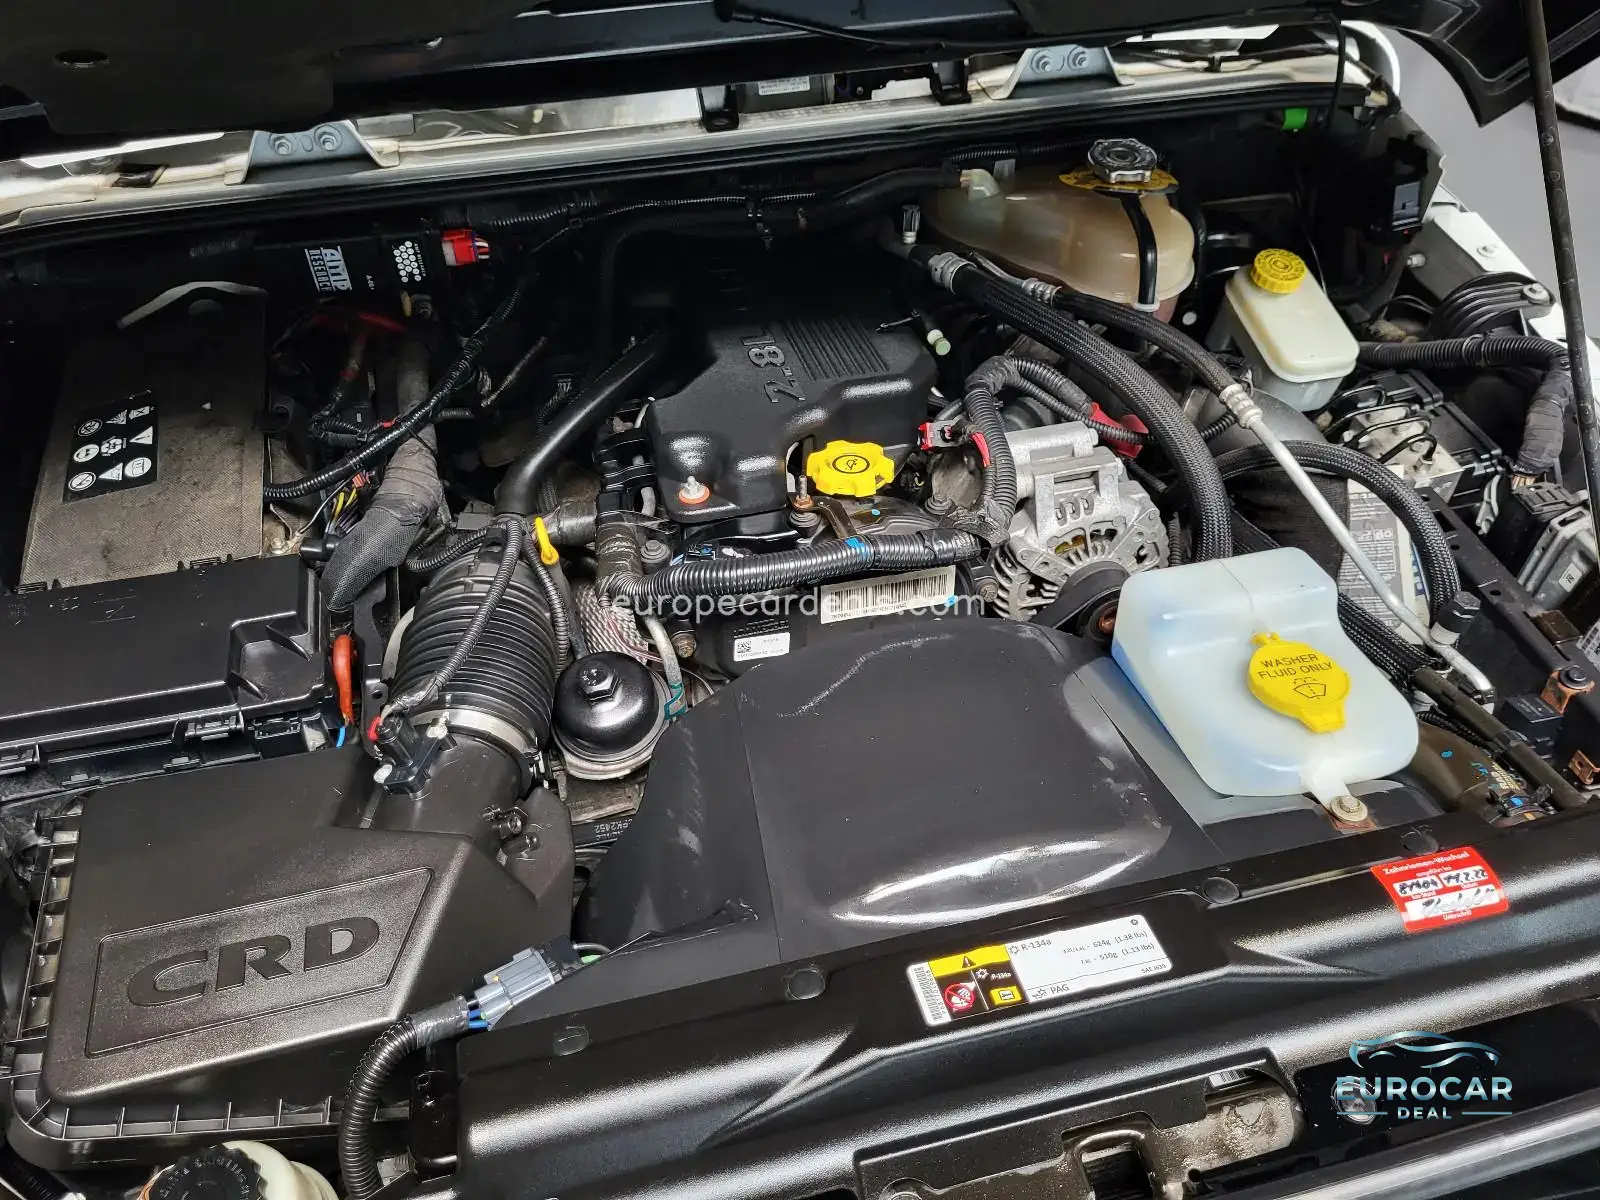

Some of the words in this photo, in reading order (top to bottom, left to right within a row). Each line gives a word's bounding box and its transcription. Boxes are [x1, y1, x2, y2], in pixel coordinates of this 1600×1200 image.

[1261, 653, 1319, 668] WASHER
[1258, 667, 1297, 679] FLUID
[1299, 662, 1333, 673] ONLY
[1134, 930, 1148, 941] lbs)
[1020, 939, 1052, 952] R-134a
[1140, 943, 1155, 953] lbs)
[127, 916, 380, 1007] CRD
[1049, 983, 1070, 995] PAG
